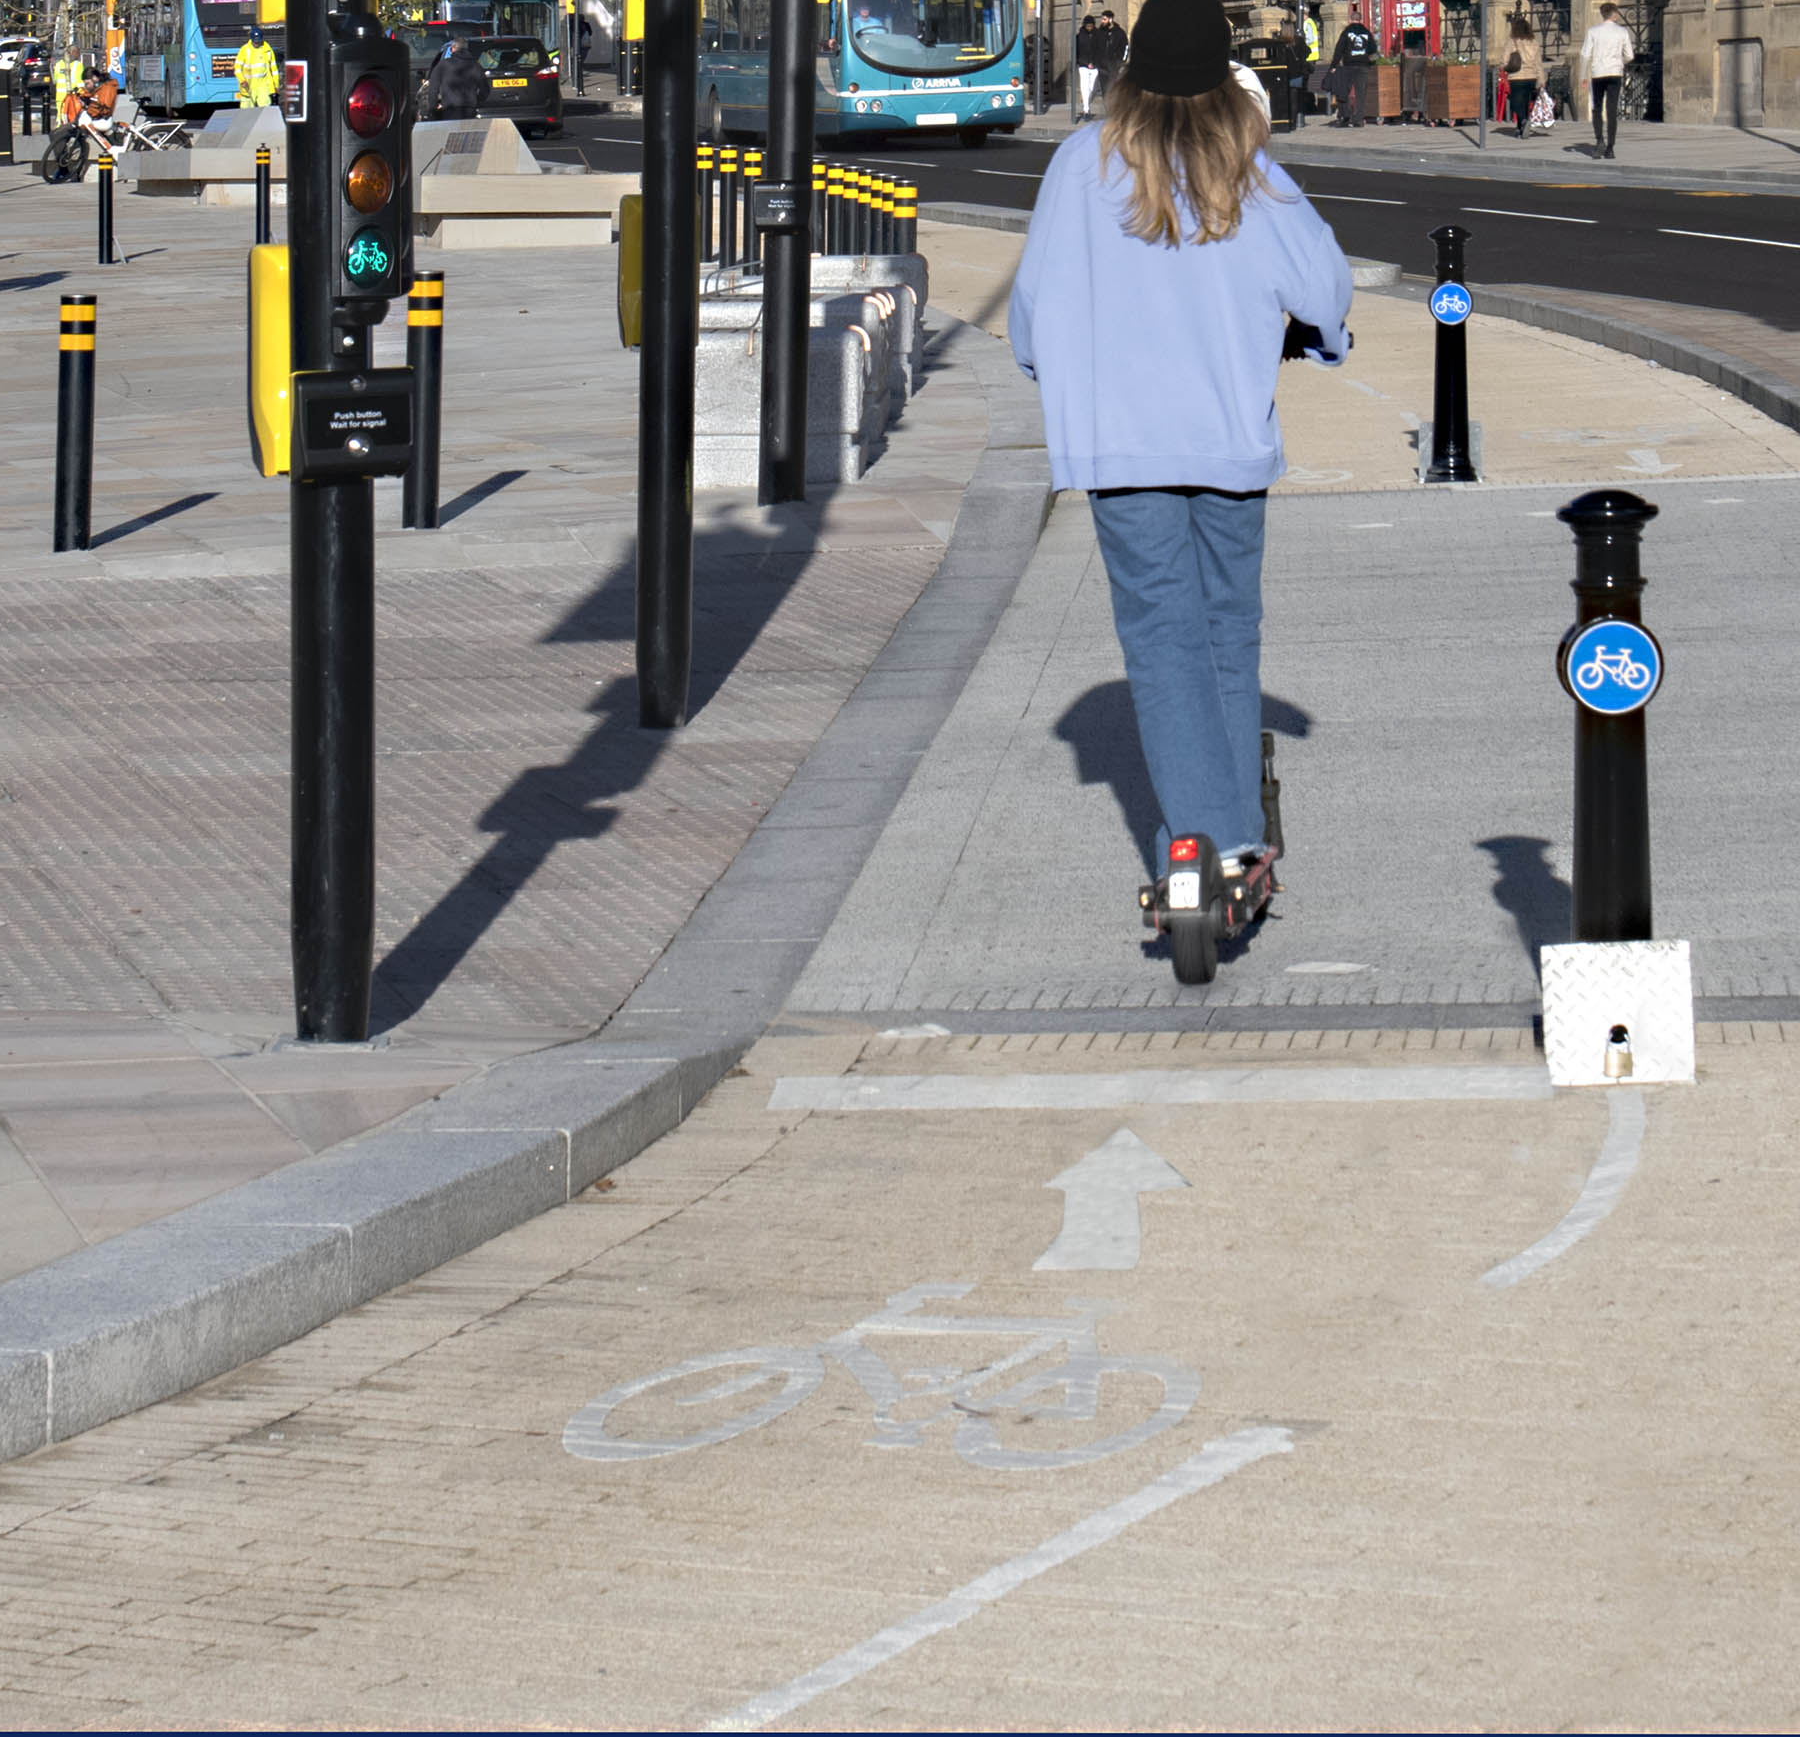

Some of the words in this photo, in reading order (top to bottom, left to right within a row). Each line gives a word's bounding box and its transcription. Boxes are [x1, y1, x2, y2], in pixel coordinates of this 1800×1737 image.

[925, 77, 962, 88] ARRIVA
[333, 411, 355, 420] Push
[356, 410, 382, 419] button
[330, 420, 348, 429] Wait
[349, 420, 361, 428] for
[362, 419, 386, 428] signal
